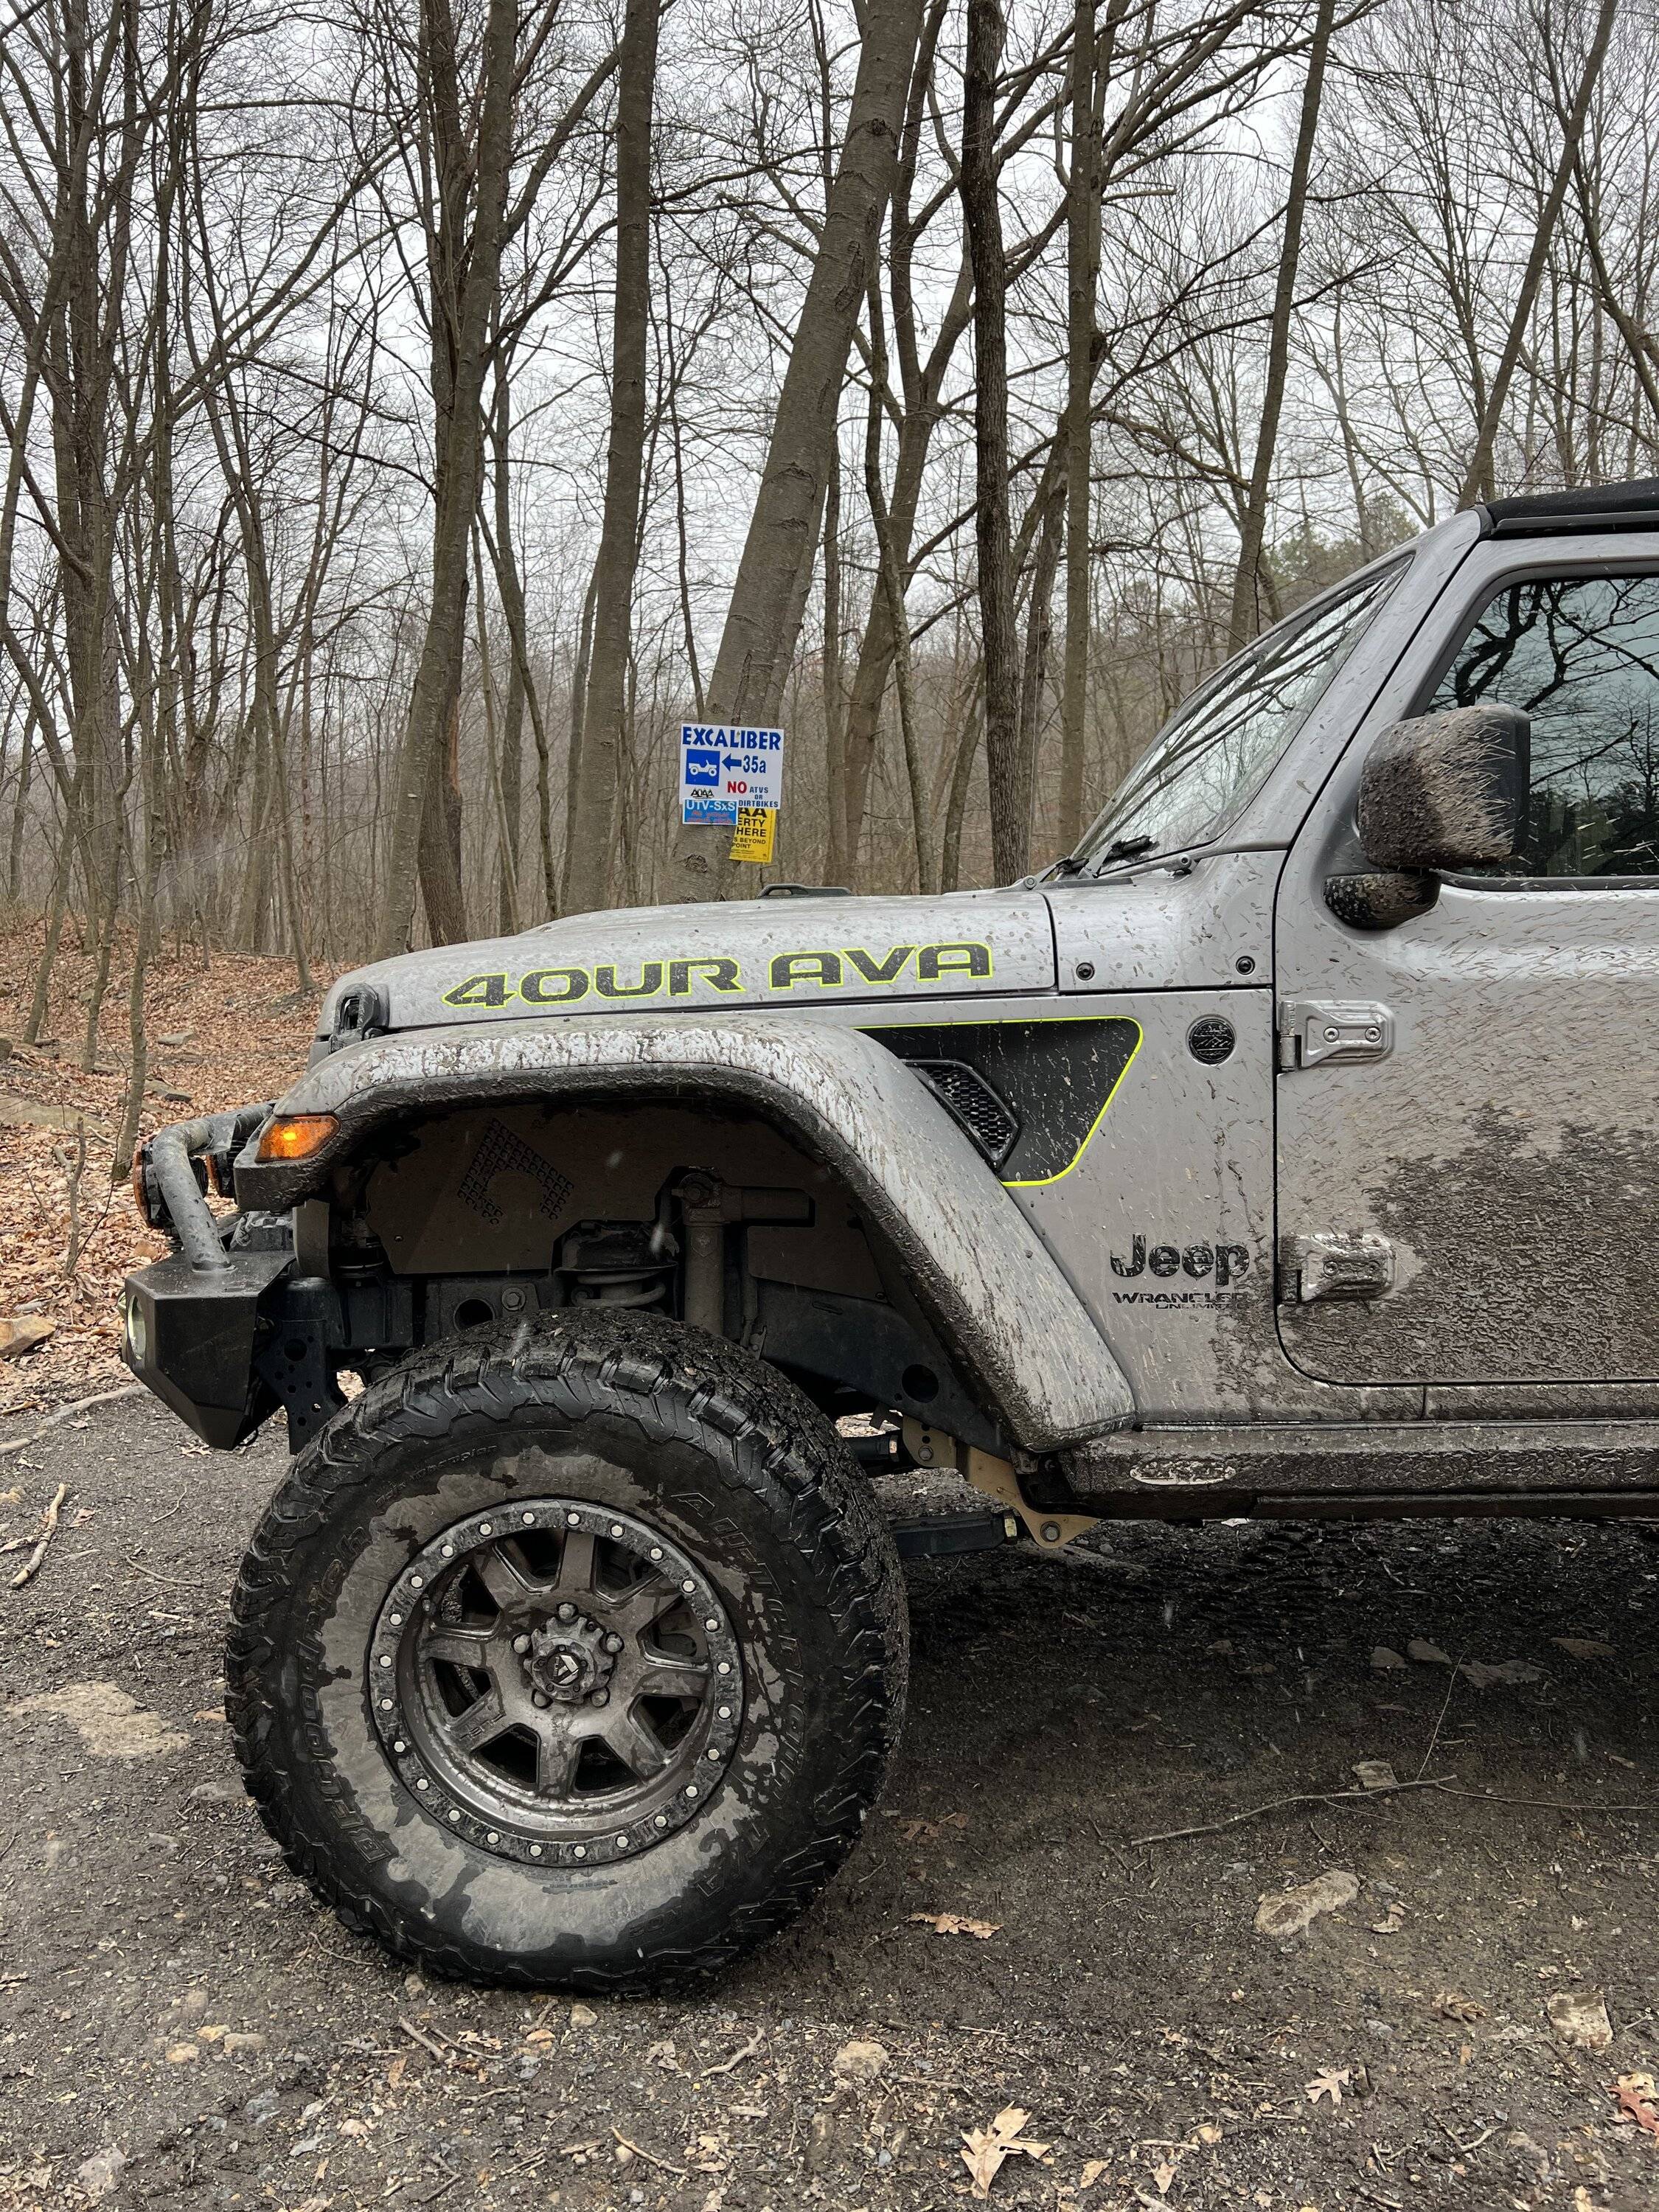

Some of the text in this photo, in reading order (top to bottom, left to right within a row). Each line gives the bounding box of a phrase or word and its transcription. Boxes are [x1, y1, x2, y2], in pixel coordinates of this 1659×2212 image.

[682, 726, 782, 751] EXCALIBER
[742, 754, 766, 773] 35a
[727, 780, 747, 793] NO
[738, 800, 779, 808] DIRTBIKES
[737, 827, 767, 837] HERE
[768, 942, 993, 990] AVA
[1110, 1232, 1250, 1285] Jeep
